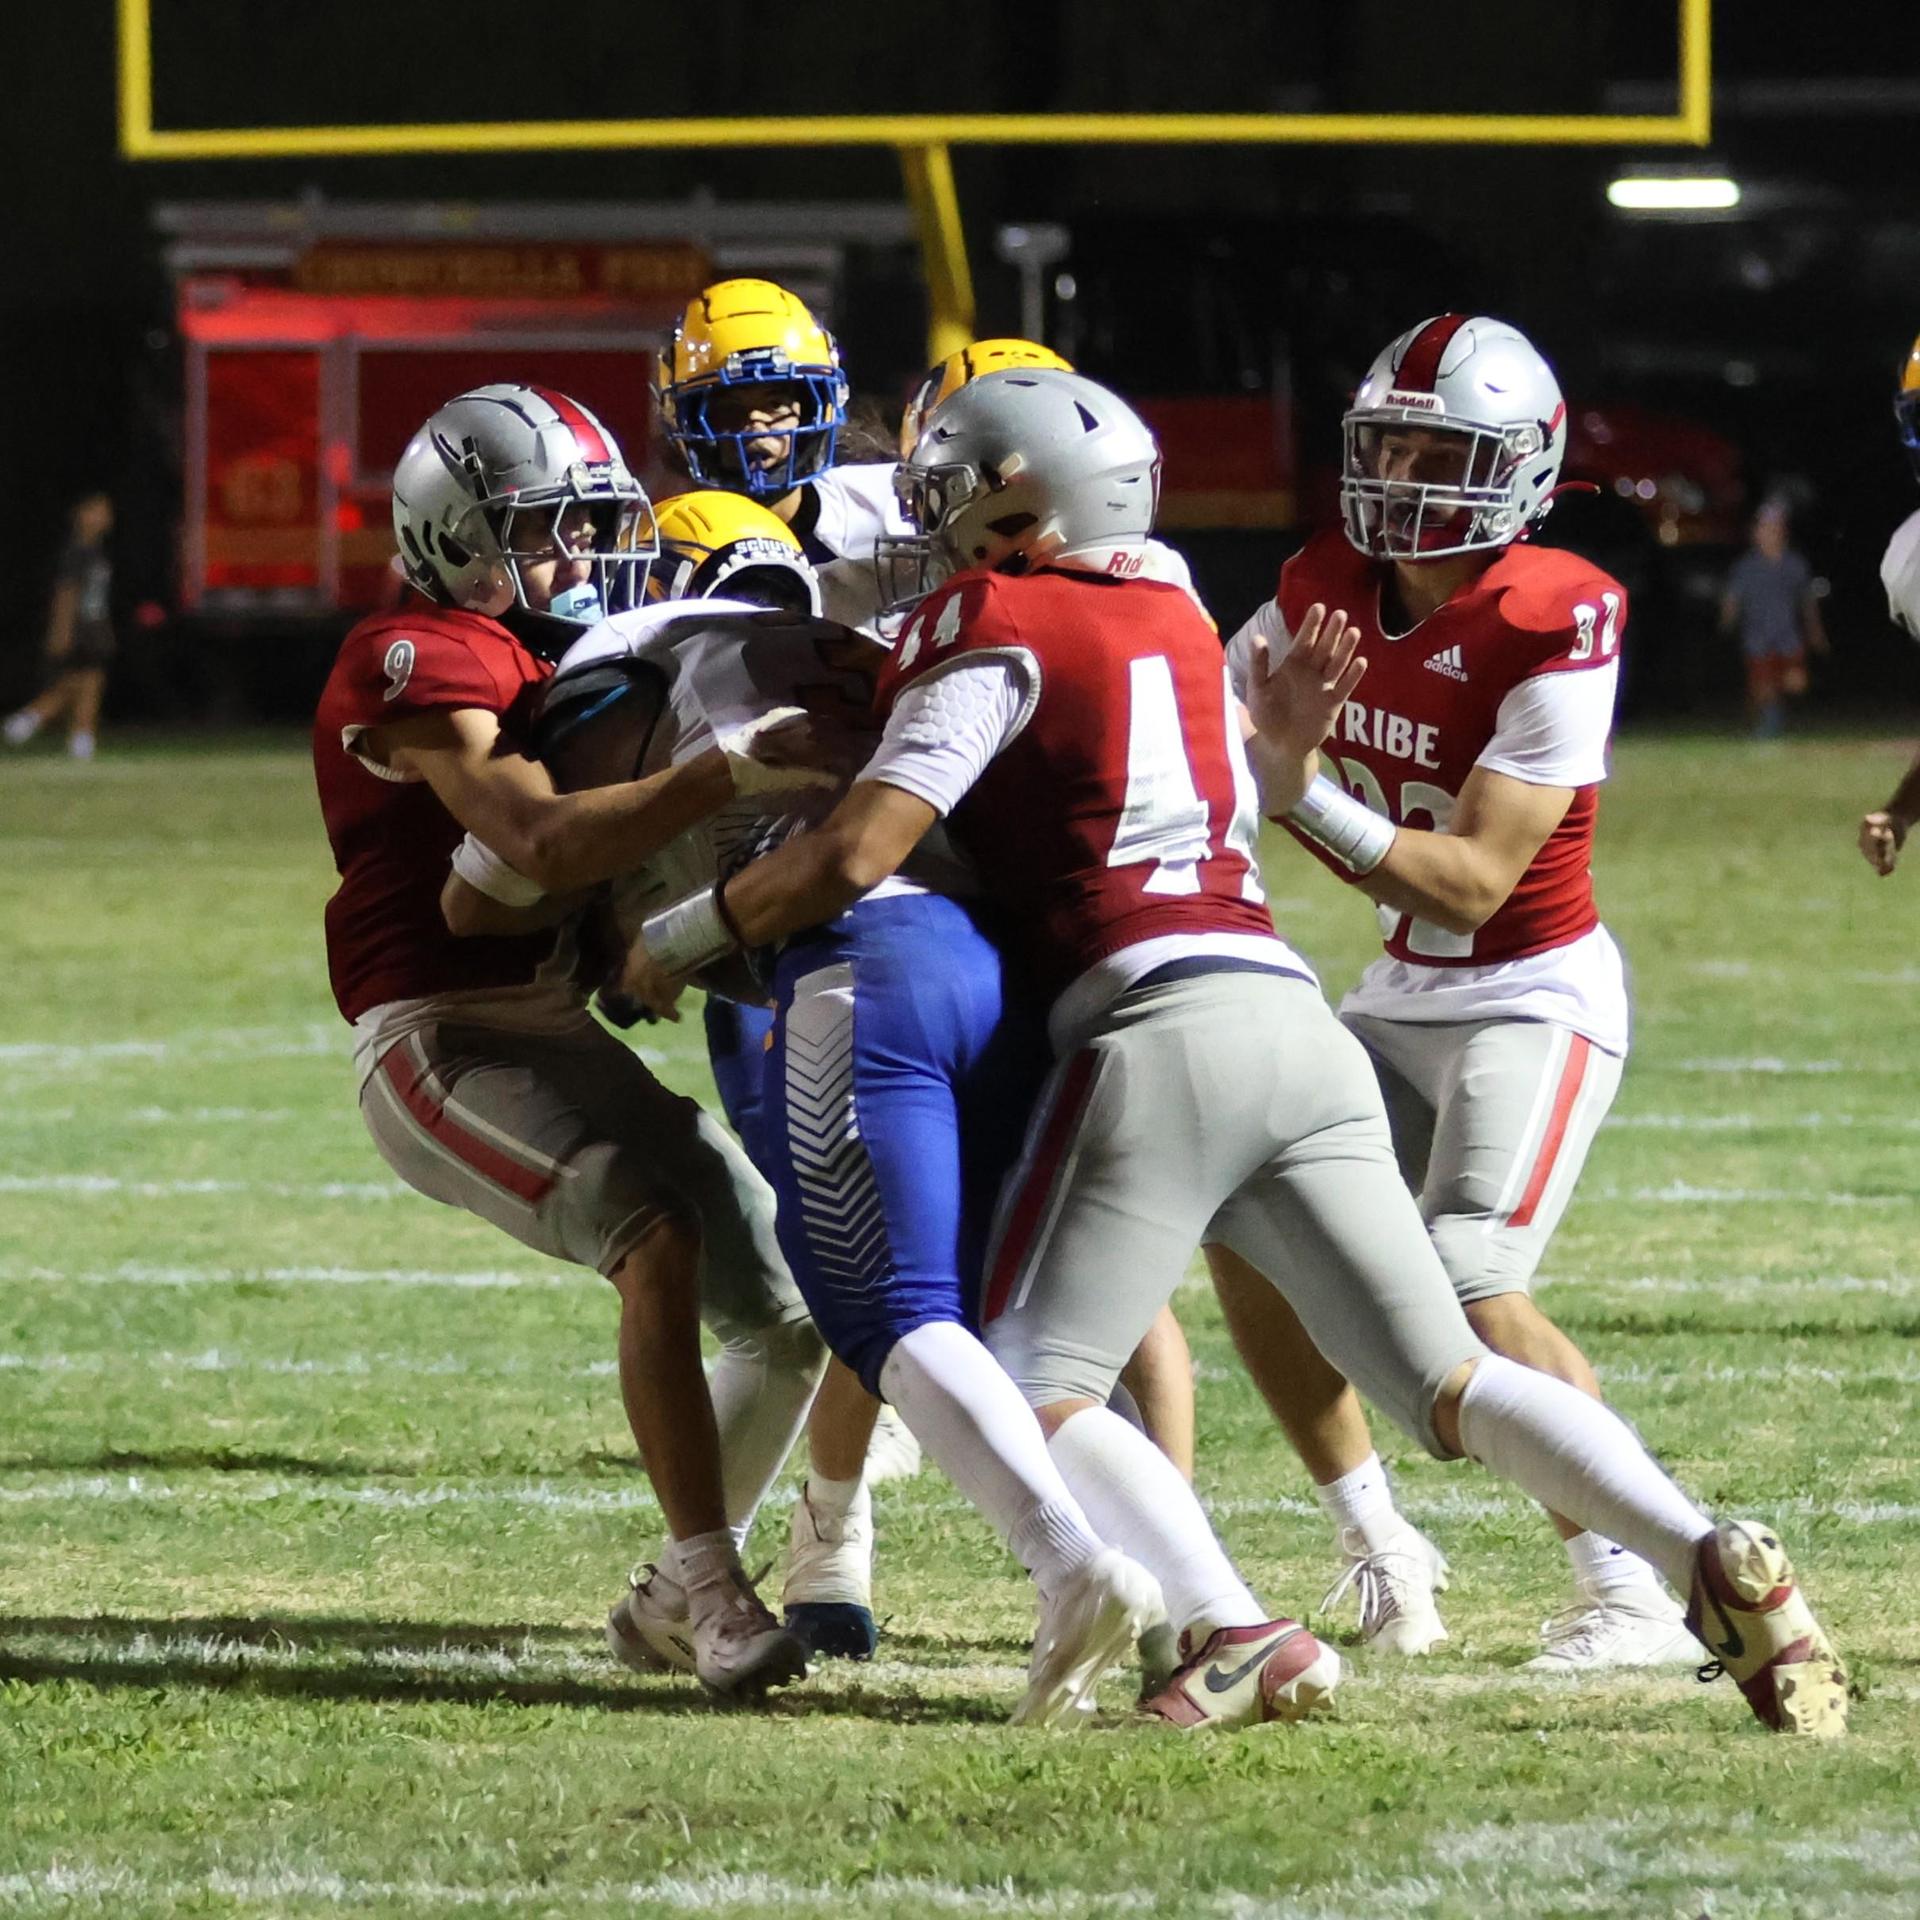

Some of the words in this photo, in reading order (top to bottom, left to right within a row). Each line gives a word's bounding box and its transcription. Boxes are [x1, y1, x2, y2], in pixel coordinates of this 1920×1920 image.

[897, 591, 962, 672] 44
[383, 640, 415, 701] 9
[1423, 659, 1468, 682] adidas
